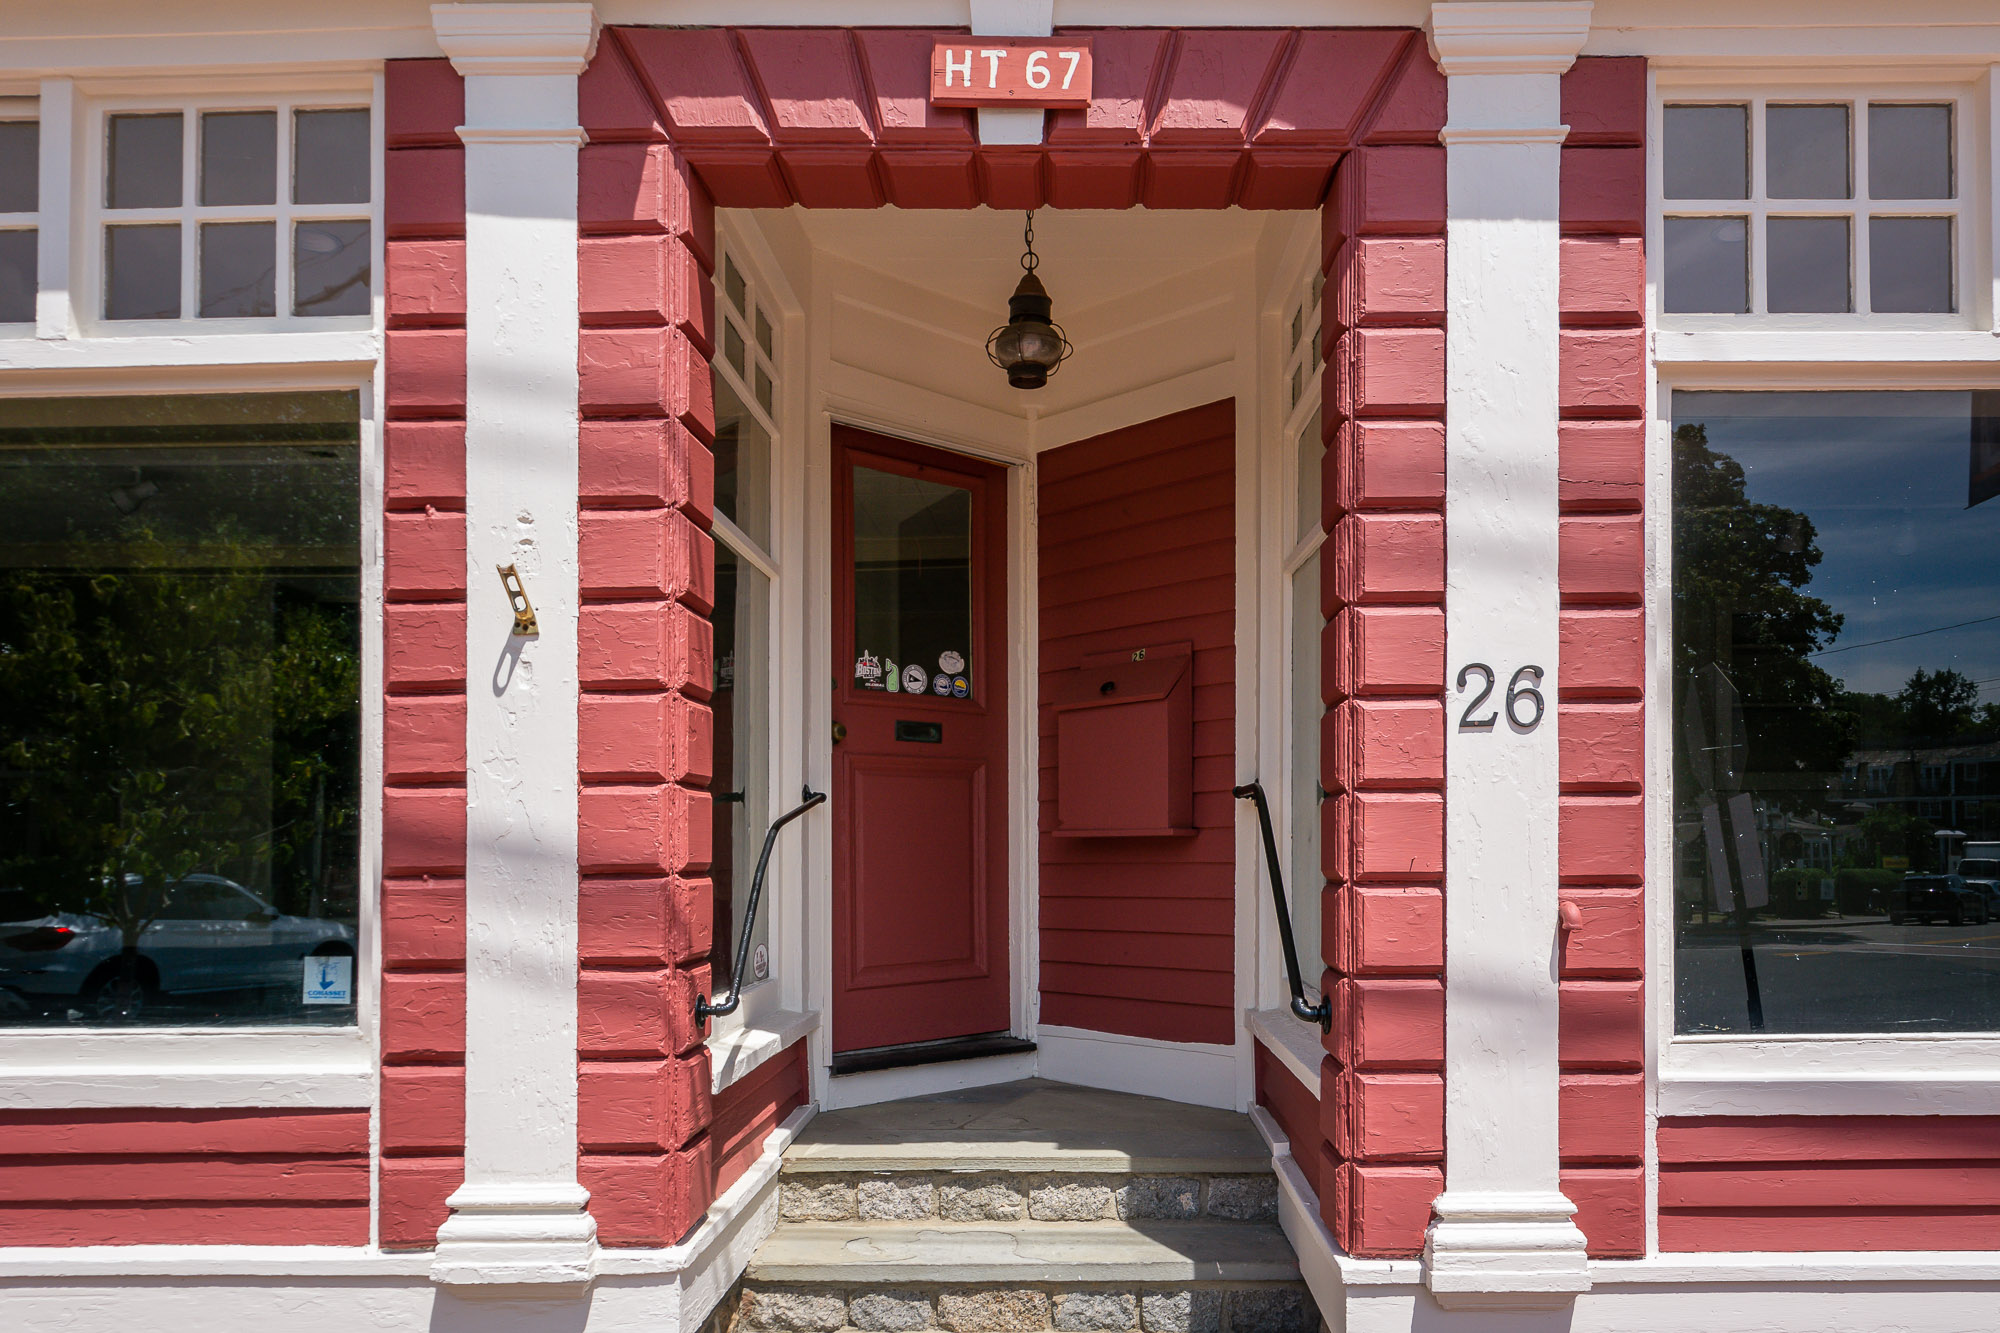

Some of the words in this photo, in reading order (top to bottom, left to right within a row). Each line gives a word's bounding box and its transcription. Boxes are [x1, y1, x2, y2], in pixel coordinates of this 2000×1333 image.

[945, 49, 1008, 89] HT
[1025, 50, 1081, 90] 67
[1132, 649, 1145, 662] 26
[1456, 662, 1545, 728] 26
